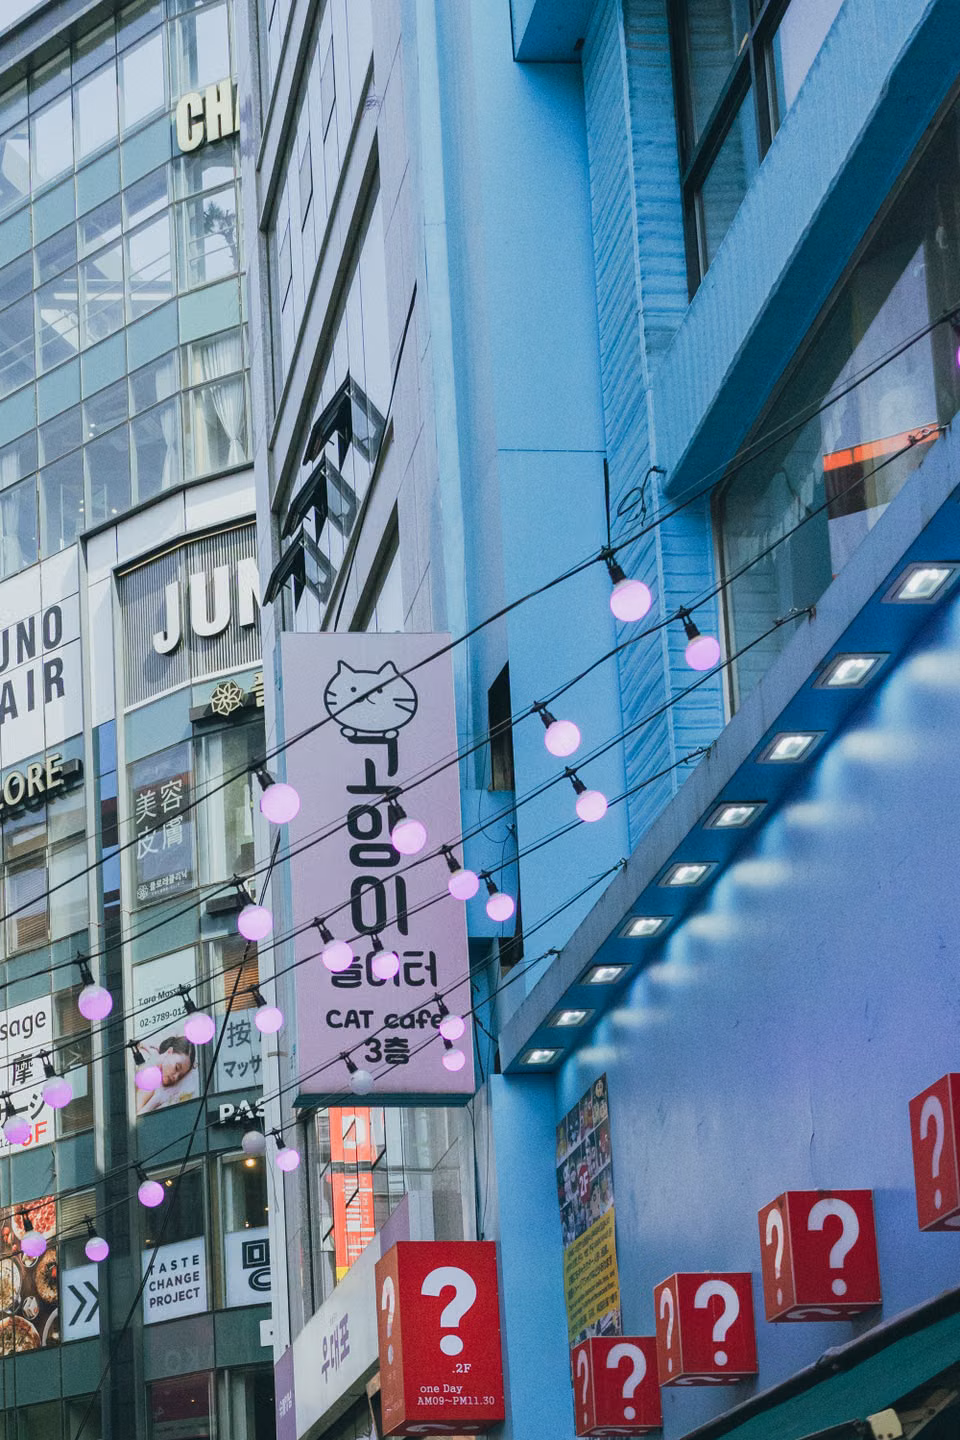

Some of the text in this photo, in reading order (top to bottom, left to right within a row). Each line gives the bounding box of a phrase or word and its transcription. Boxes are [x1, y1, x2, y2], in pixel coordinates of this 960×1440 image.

[176, 77, 240, 153] CH
[136, 779, 184, 825] 美容
[139, 1006, 187, 1028] 02-3789-012
[326, 1007, 443, 1030] CAT cafe
[363, 1037, 410, 1065] 3층
[149, 1253, 201, 1276] TASTE
[149, 1270, 201, 1293] CHANGE
[149, 1287, 201, 1309] PROJECT
[321, 1312, 351, 1385] 우대포
[420, 1383, 464, 1396] one Day
